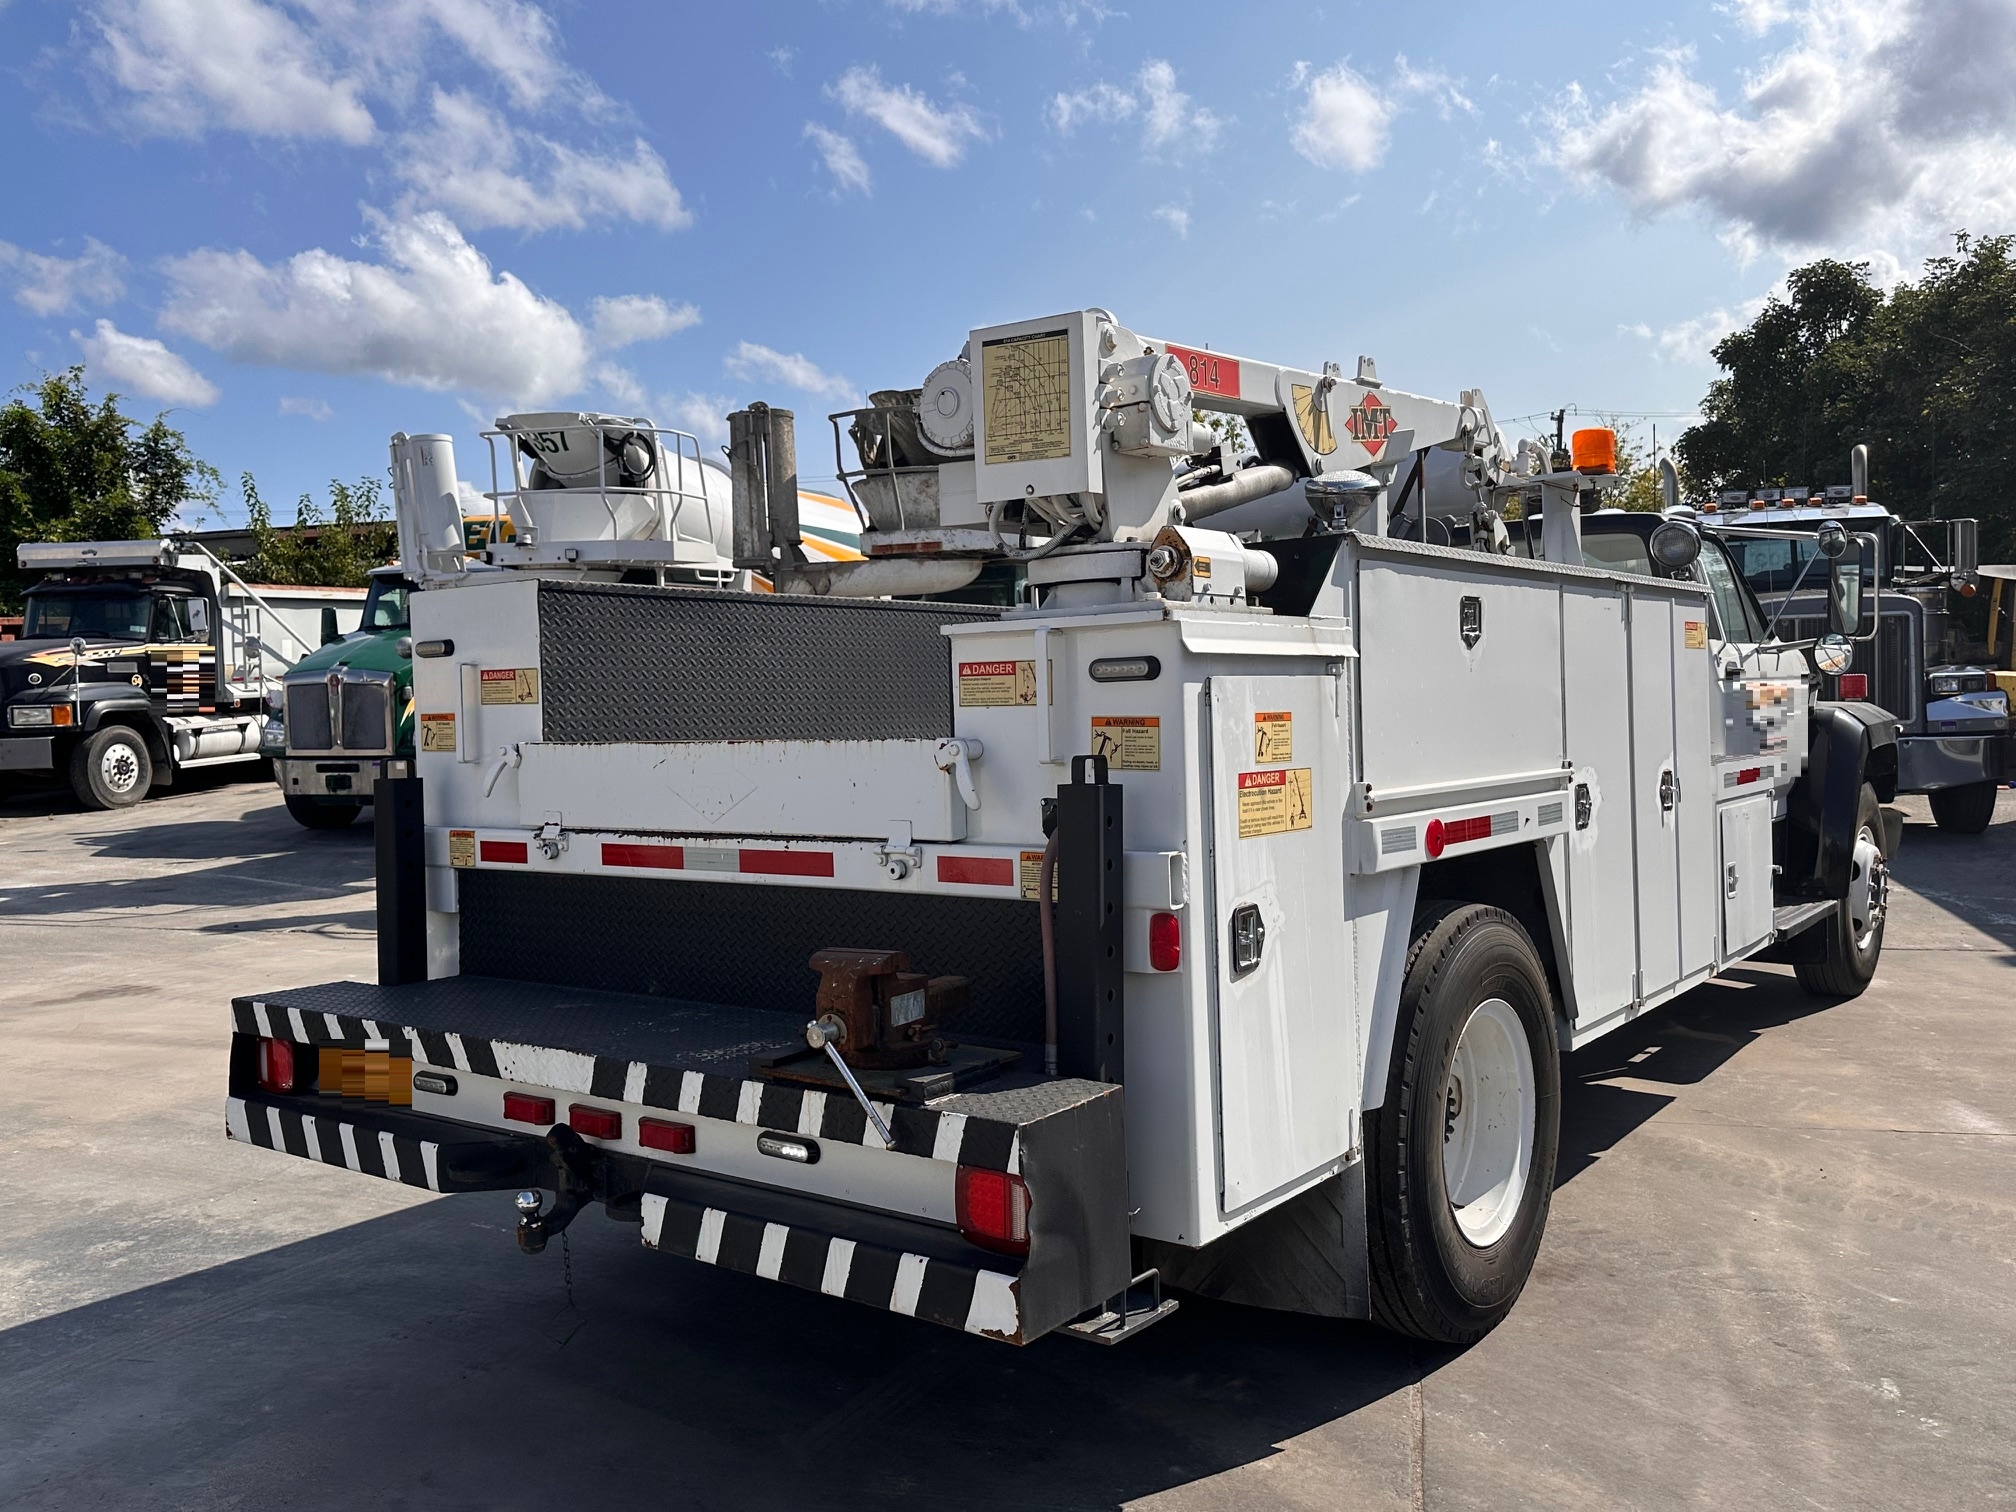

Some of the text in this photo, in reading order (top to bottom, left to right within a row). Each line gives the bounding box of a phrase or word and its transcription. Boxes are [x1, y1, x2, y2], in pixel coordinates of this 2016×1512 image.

[1188, 354, 1220, 390] 814
[1350, 406, 1391, 441] IMT
[972, 663, 1013, 675] DANGER
[488, 671, 515, 680] DANGER
[1252, 772, 1280, 785] DANGER
[1239, 788, 1267, 798] Electrocution
